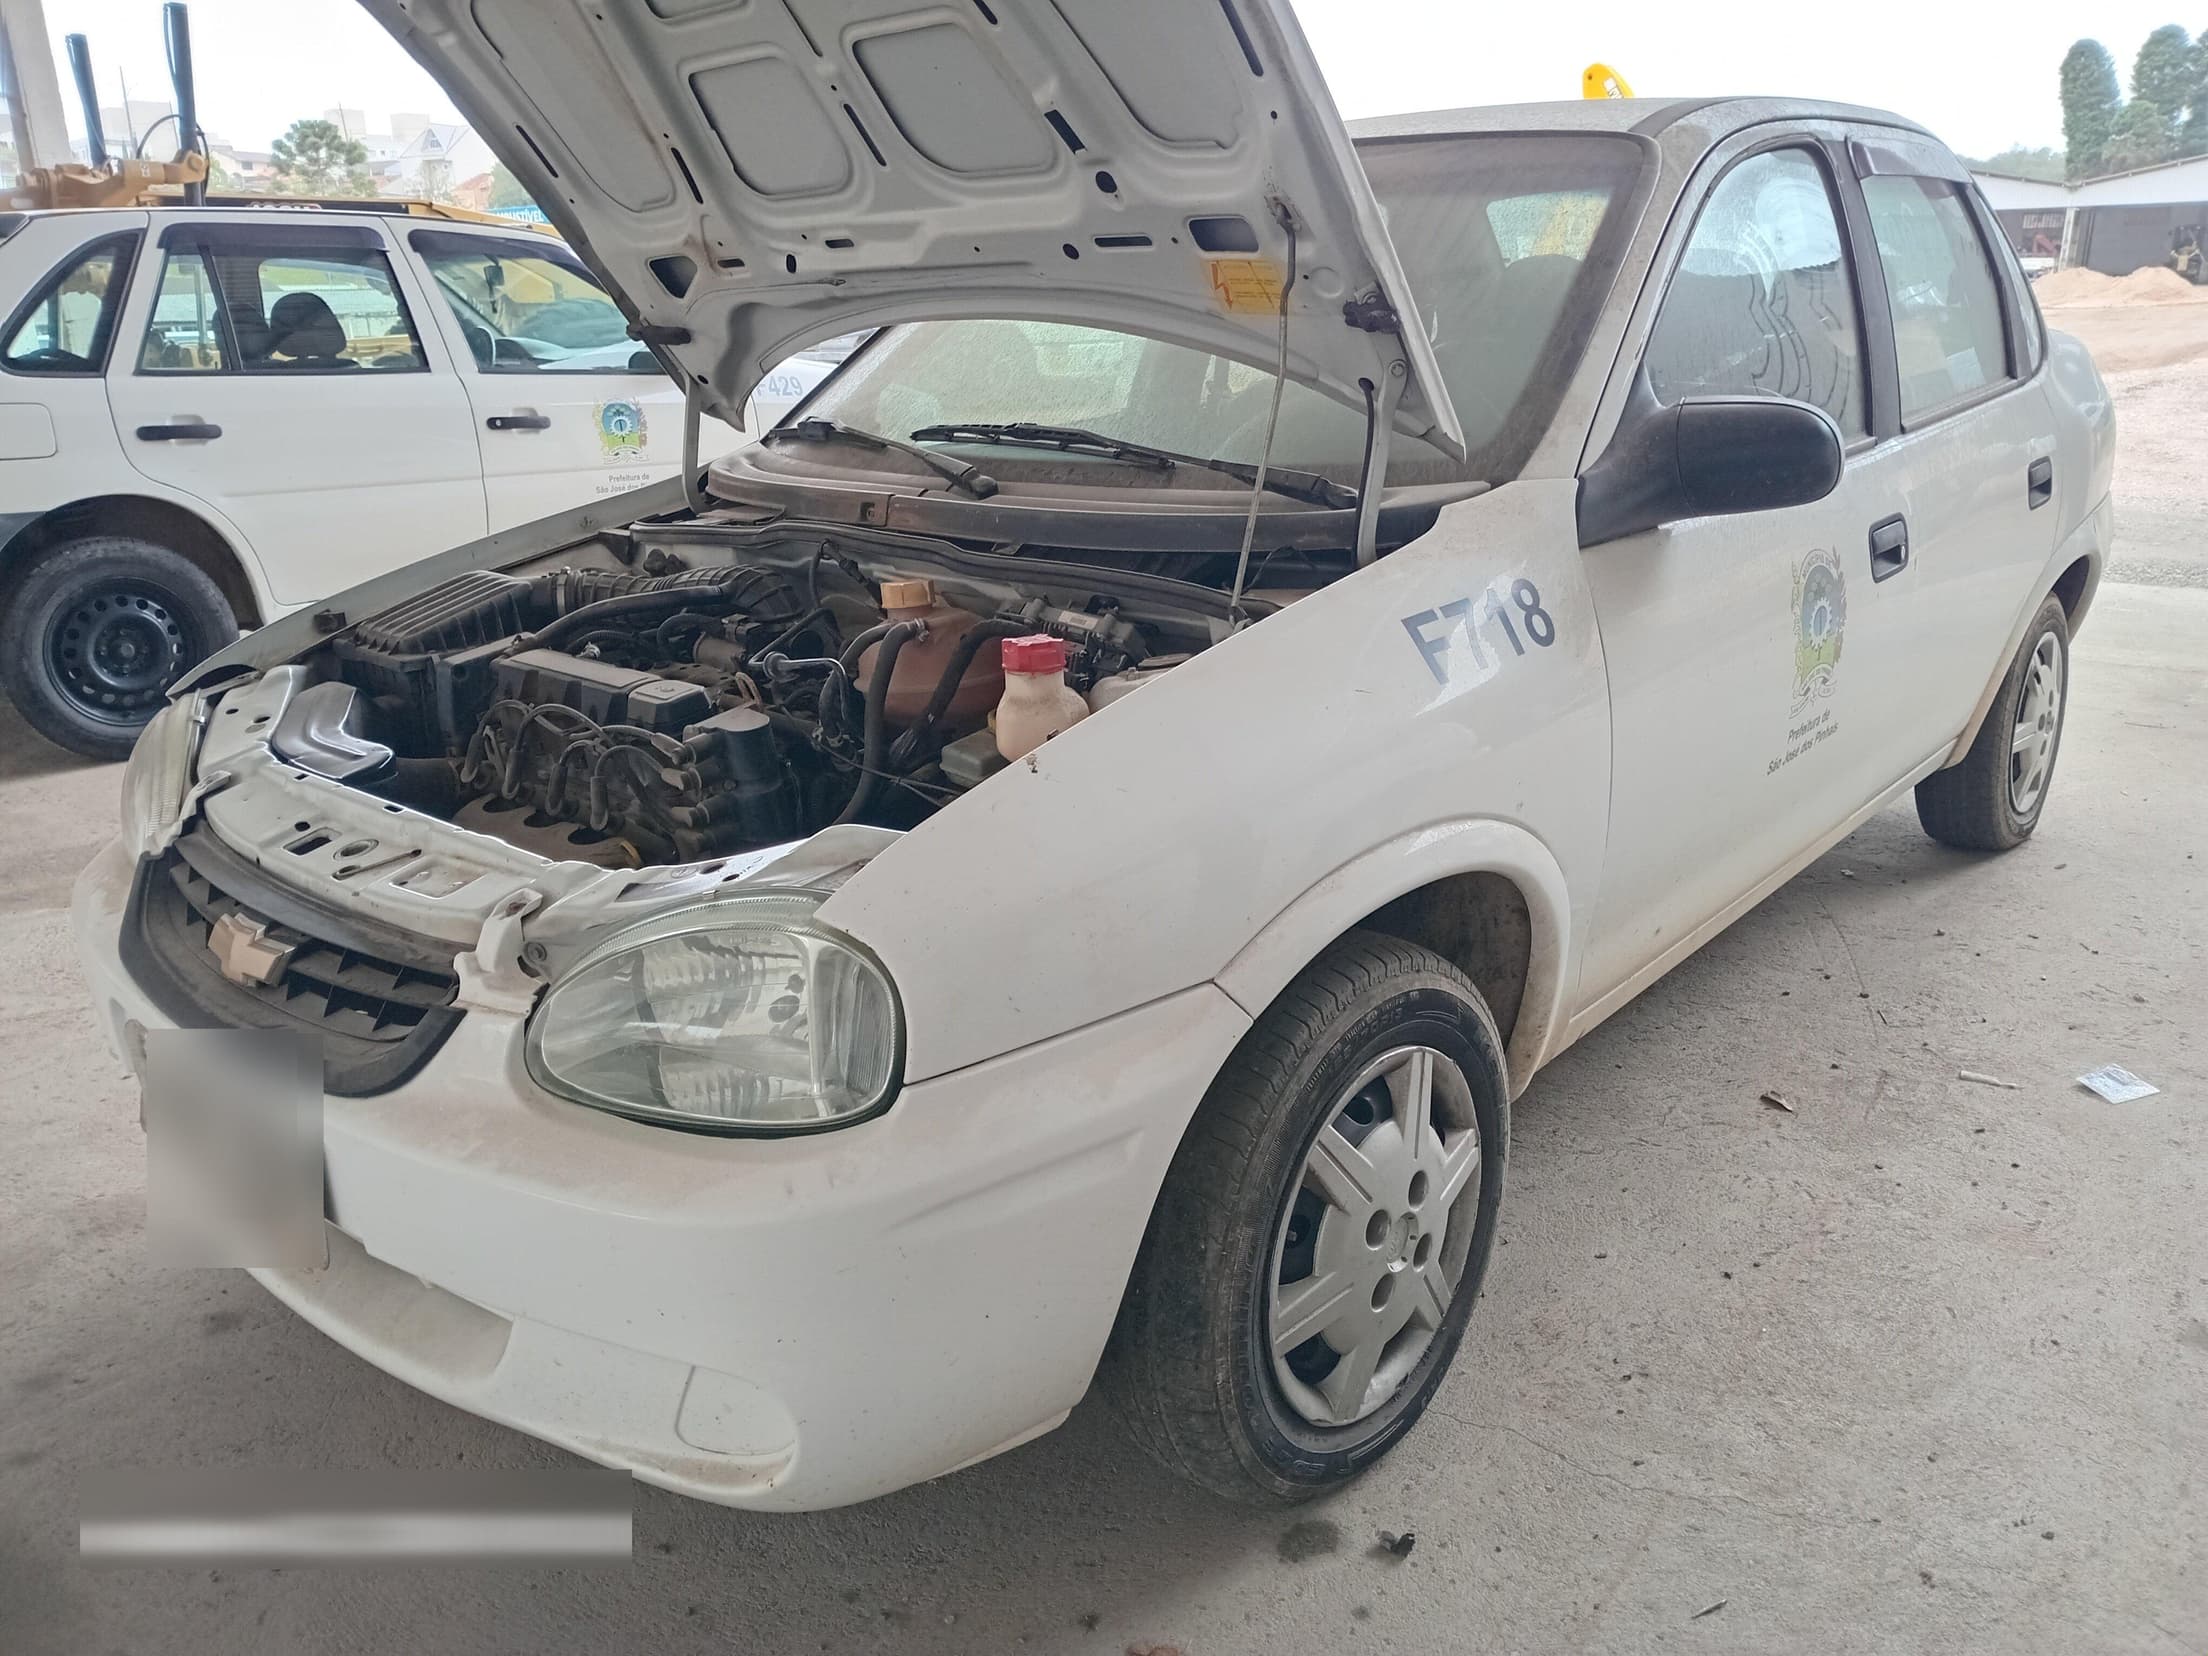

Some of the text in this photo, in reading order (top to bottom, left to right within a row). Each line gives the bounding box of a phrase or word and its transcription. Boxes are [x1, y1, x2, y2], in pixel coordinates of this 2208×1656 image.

[1401, 578, 1555, 685] F718
[1767, 755, 1782, 776] São
[1800, 737, 1814, 754] dos
[1814, 721, 1840, 746] Pinhais
[1787, 715, 1821, 745] Prefeitura
[1821, 707, 1831, 723] de
